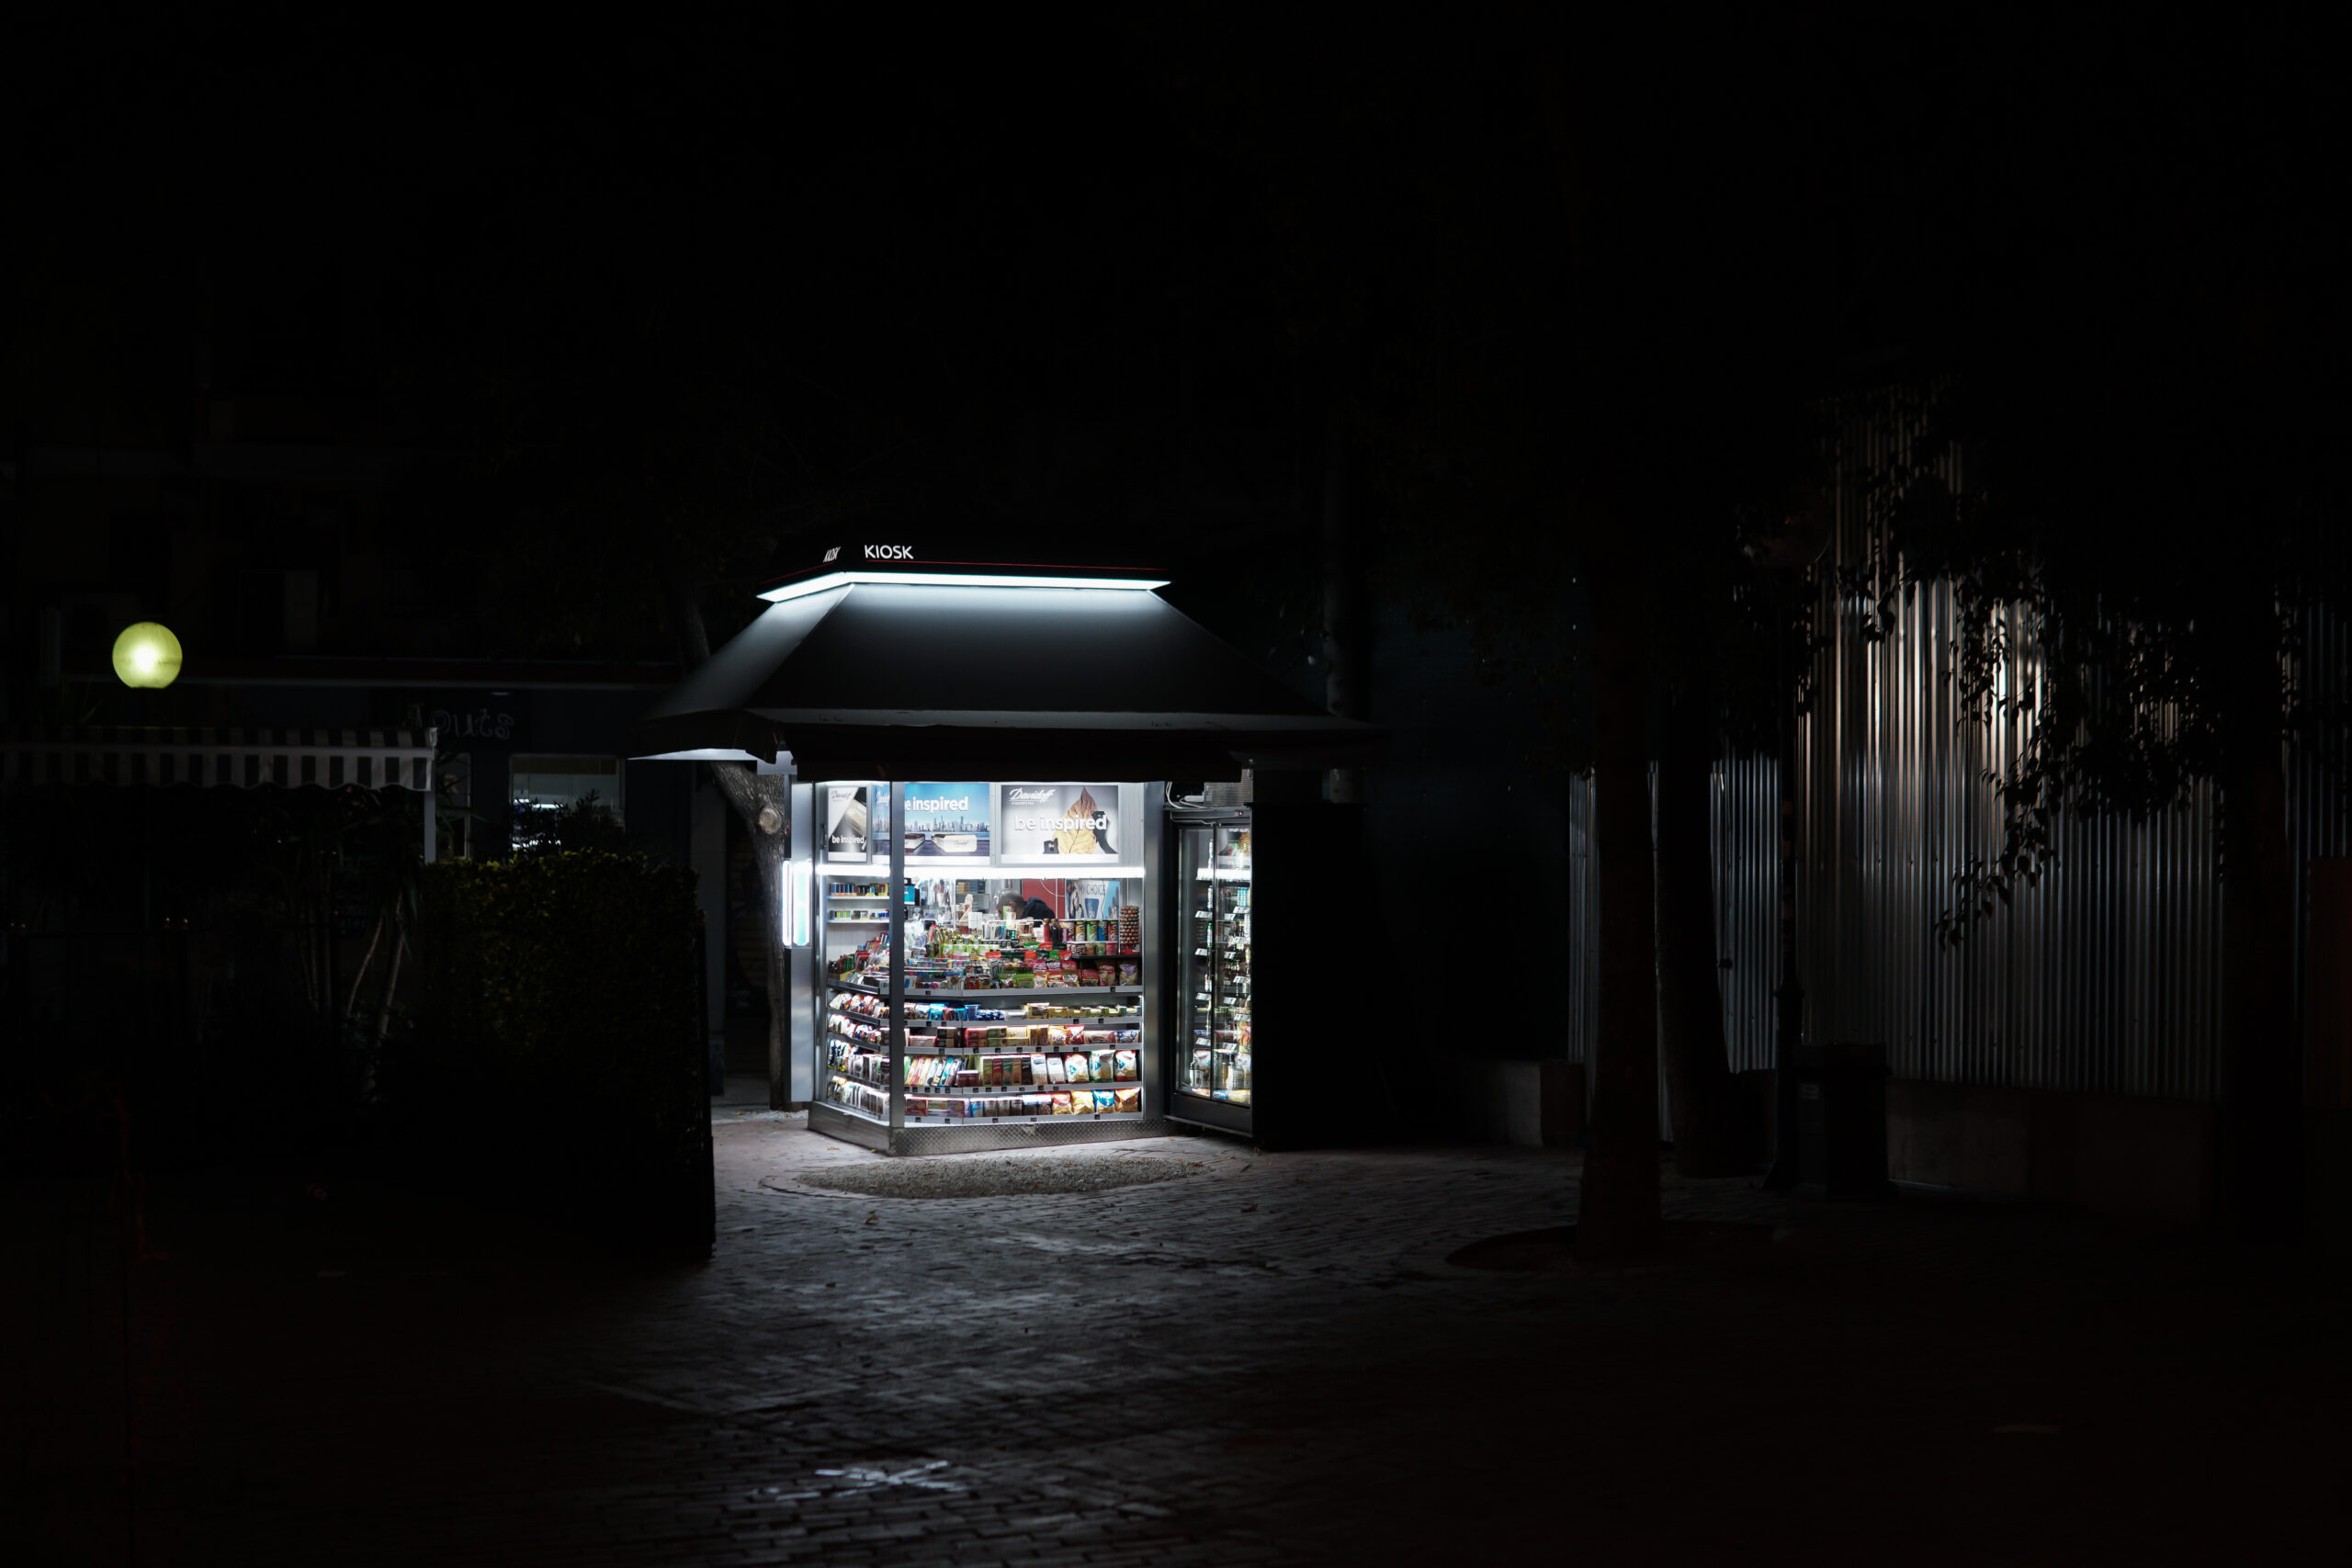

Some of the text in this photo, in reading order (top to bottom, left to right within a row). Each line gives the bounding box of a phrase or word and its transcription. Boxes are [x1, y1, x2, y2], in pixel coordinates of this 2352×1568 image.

[823, 547, 841, 563] KIOSK
[865, 545, 914, 559] KIOSK
[1010, 787, 1056, 803] Davidoff
[912, 796, 968, 814] inspired
[1014, 814, 1107, 833] be inspired
[831, 835, 865, 845] be inspired
[1087, 884, 1105, 897] CHOICE
